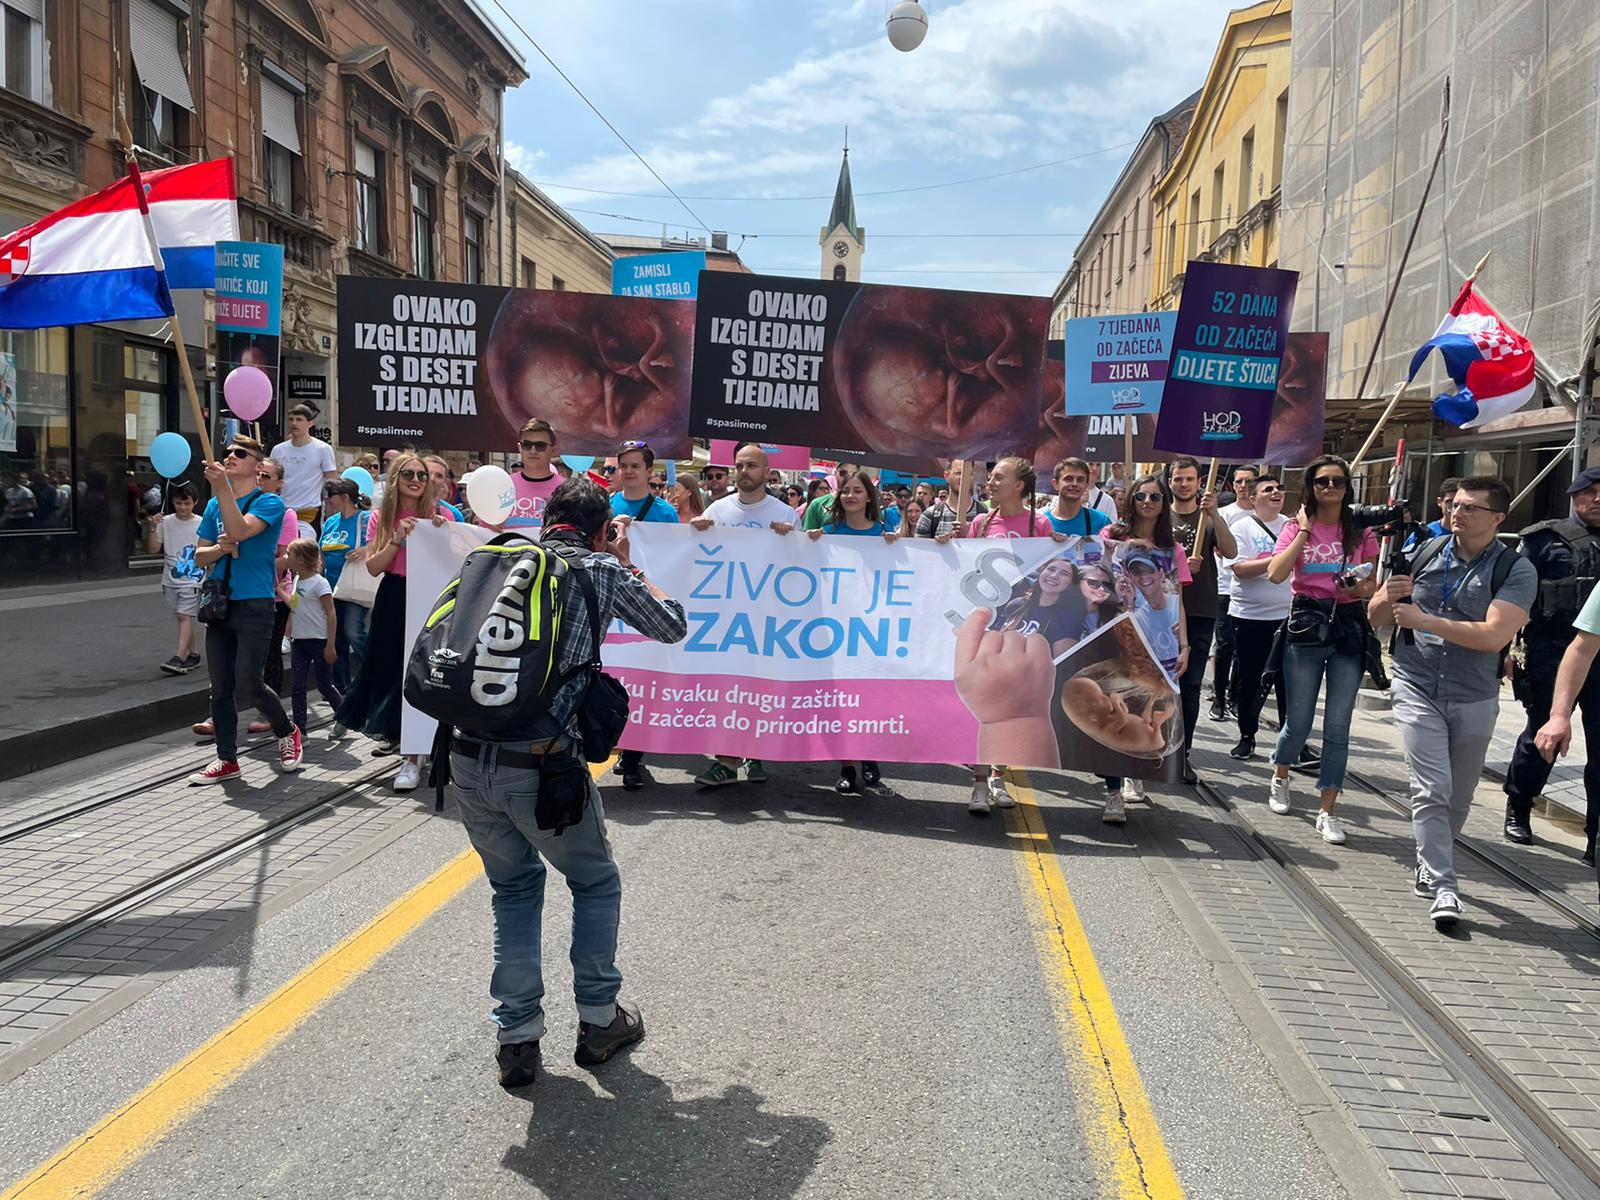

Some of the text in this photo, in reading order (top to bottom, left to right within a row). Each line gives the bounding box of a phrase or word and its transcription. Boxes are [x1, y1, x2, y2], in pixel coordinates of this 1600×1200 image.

[242, 253, 260, 269] SVE
[633, 263, 671, 279] ZAMISLI
[246, 279, 268, 295] KOJI
[633, 284, 653, 297] SAM
[654, 281, 691, 296] STABLO
[232, 303, 261, 320] DIJETE
[393, 294, 476, 326] OVAKO
[748, 289, 828, 322] OVAKO
[1211, 290, 1278, 317] 52 DANA
[354, 323, 476, 356] IZGLEDAM
[710, 317, 825, 352] IZGLEDAM
[1098, 317, 1161, 336] 7 TJEDANA
[1195, 324, 1278, 351] OD ZAČEĆA
[1097, 336, 1163, 357] OD ZAČEĆA
[380, 355, 477, 386] S DESET
[731, 349, 824, 381] S DESET
[1109, 363, 1149, 380] ZIJEVA
[1177, 355, 1277, 385] DIJETE ŠTUCA
[372, 384, 477, 416] TJEDANA
[723, 378, 820, 411] TJEDANA
[357, 425, 424, 437] #spasiimene
[706, 418, 767, 430] #spasiimene
[1203, 410, 1241, 427] HOD
[689, 543, 915, 614] ŽIVOT JE
[470, 559, 537, 706] arena
[683, 612, 911, 659] ZAKON!
[620, 676, 860, 713] ku i svaku drugu zaštitu
[629, 704, 910, 738] d začeća do prirodne smrti.
